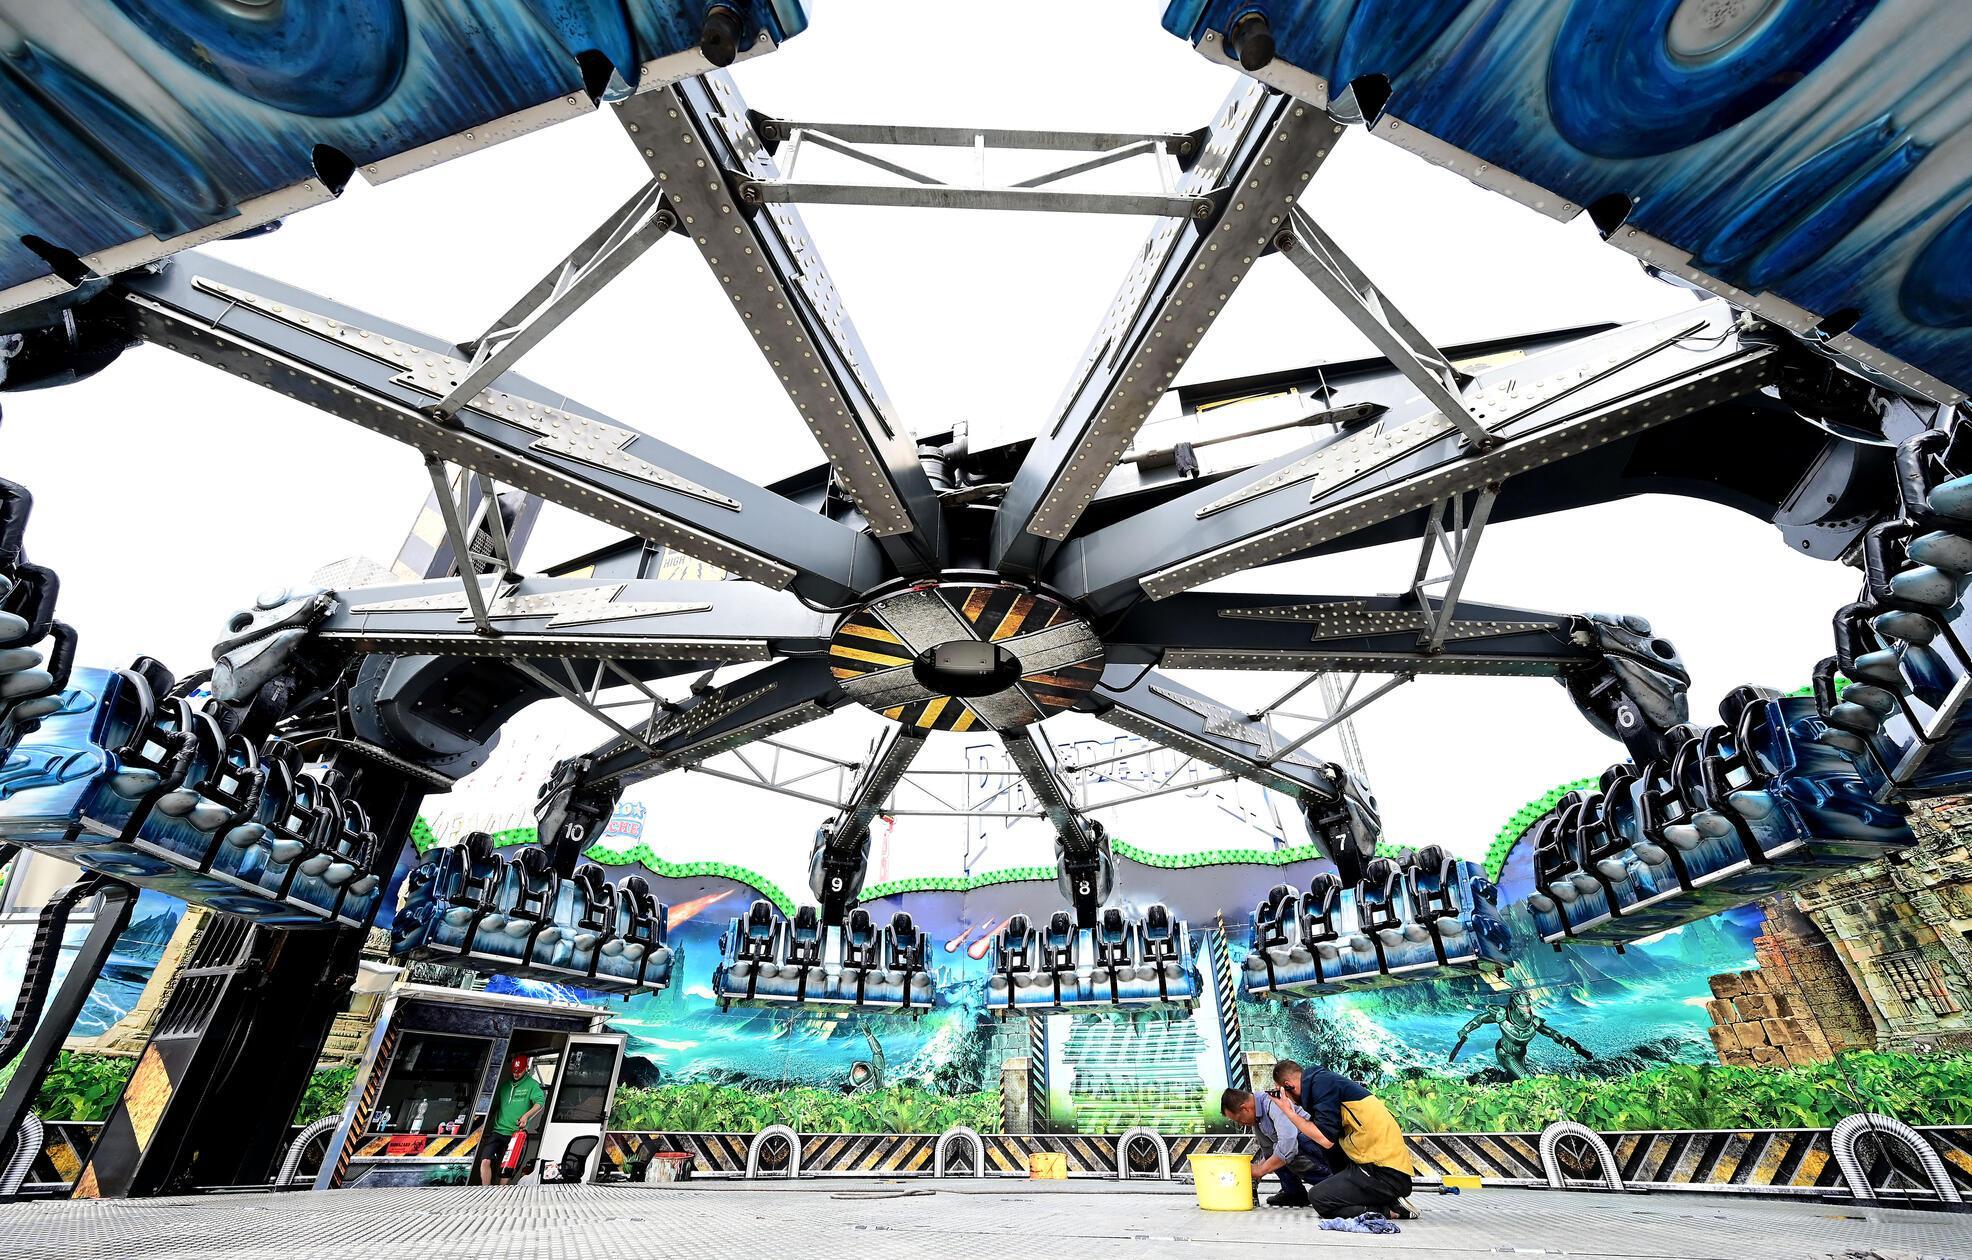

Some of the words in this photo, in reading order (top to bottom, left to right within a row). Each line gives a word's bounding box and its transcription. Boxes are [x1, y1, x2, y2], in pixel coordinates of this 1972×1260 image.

[1868, 387, 1893, 420] 5
[663, 556, 685, 568] HIGH
[1617, 705, 1635, 728] 6
[564, 822, 585, 842] 10
[1335, 833, 1347, 851] 7
[831, 877, 843, 892] 9
[1079, 880, 1091, 895] 8
[1075, 1072, 1204, 1111] DANGER
